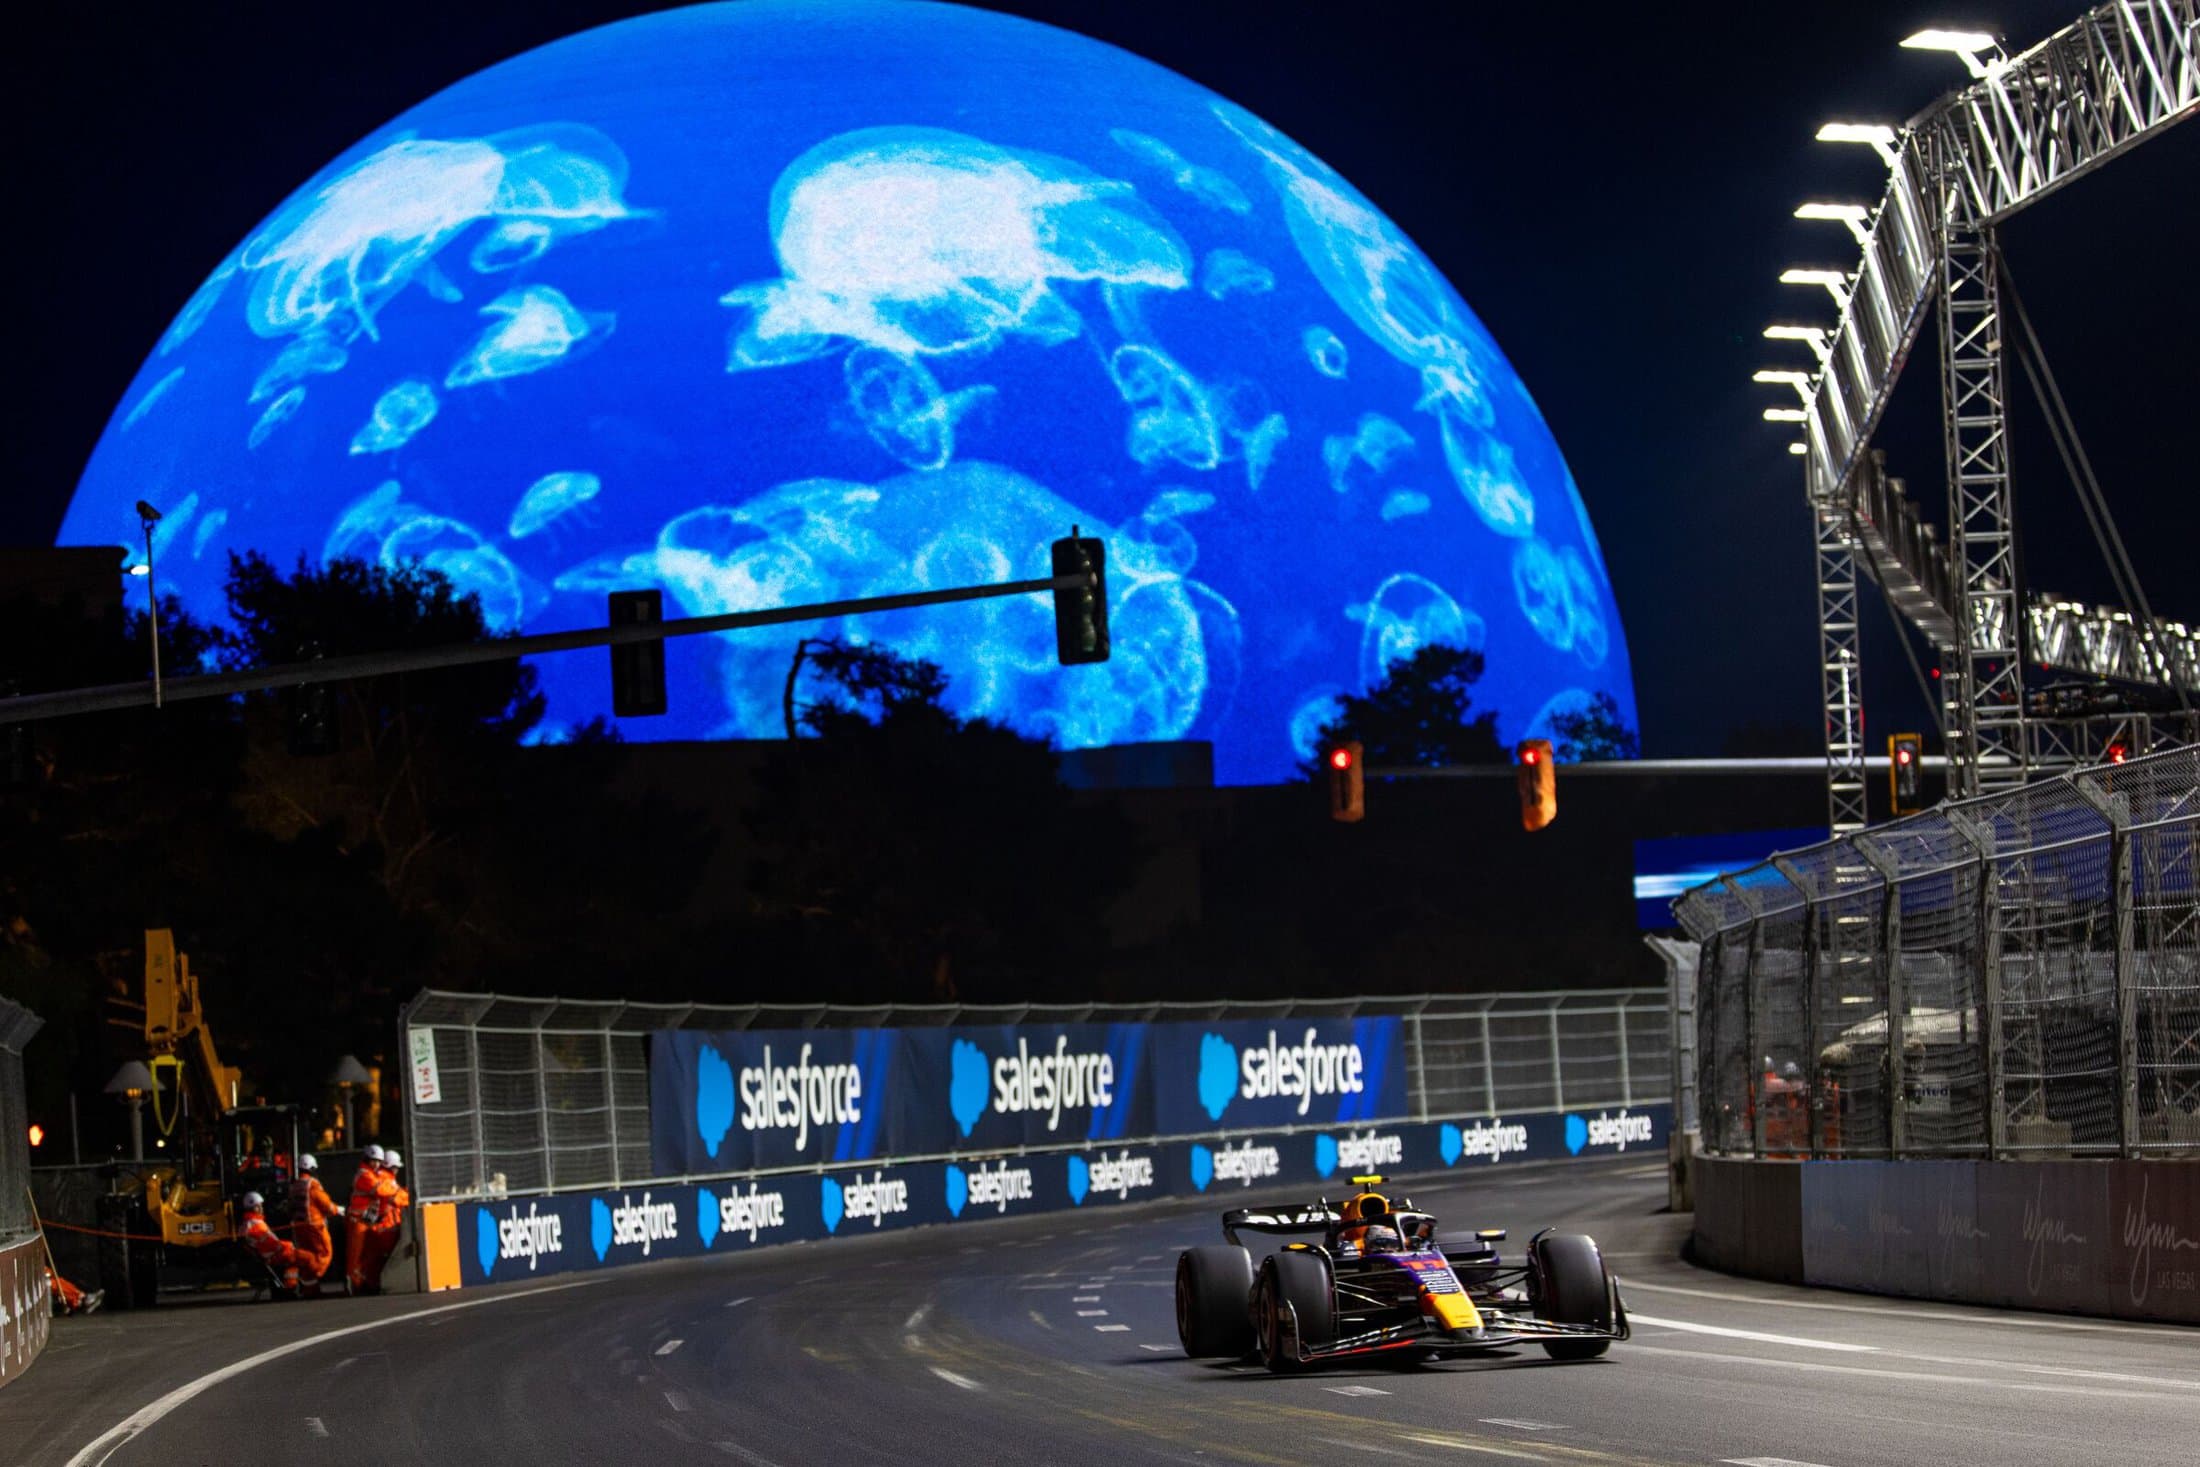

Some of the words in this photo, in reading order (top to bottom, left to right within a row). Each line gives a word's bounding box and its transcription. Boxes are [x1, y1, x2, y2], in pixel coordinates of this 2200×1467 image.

[740, 1043, 862, 1152] salesforce
[993, 1034, 1114, 1132] salesforce
[1241, 1027, 1364, 1116] salesforce
[1337, 1128, 1403, 1175] salesforce
[1462, 1118, 1528, 1163] salesforce
[1587, 1109, 1653, 1152] salesforce
[968, 1159, 1033, 1213] salesforce
[1089, 1150, 1154, 1200] salesforce
[1213, 1138, 1280, 1187] salesforce
[613, 1192, 678, 1256] salesforce
[720, 1182, 785, 1243] salesforce
[844, 1170, 908, 1228] salesforce
[500, 1202, 562, 1271] salesforce
[2023, 1171, 2088, 1296] Wynn
[2124, 1172, 2199, 1306] Wynn
